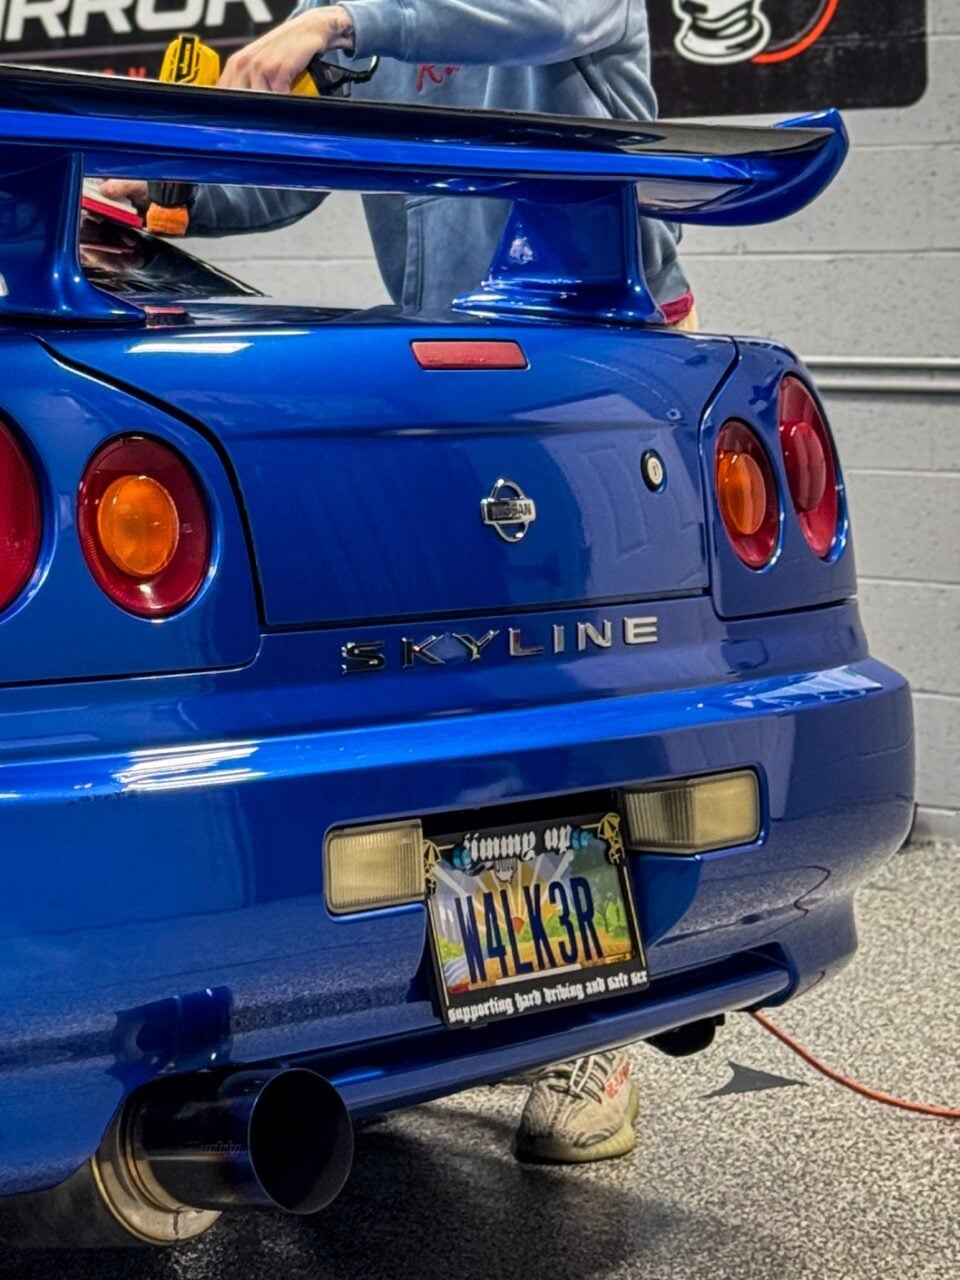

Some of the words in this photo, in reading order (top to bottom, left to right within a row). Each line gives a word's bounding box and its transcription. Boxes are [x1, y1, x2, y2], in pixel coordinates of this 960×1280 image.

[342, 616, 658, 674] SKYLINE
[544, 824, 572, 855] up
[455, 877, 603, 984] W4LK3R
[447, 996, 514, 1024] supporting
[515, 989, 542, 1012] hard
[585, 976, 606, 995] and
[630, 970, 648, 985] sex
